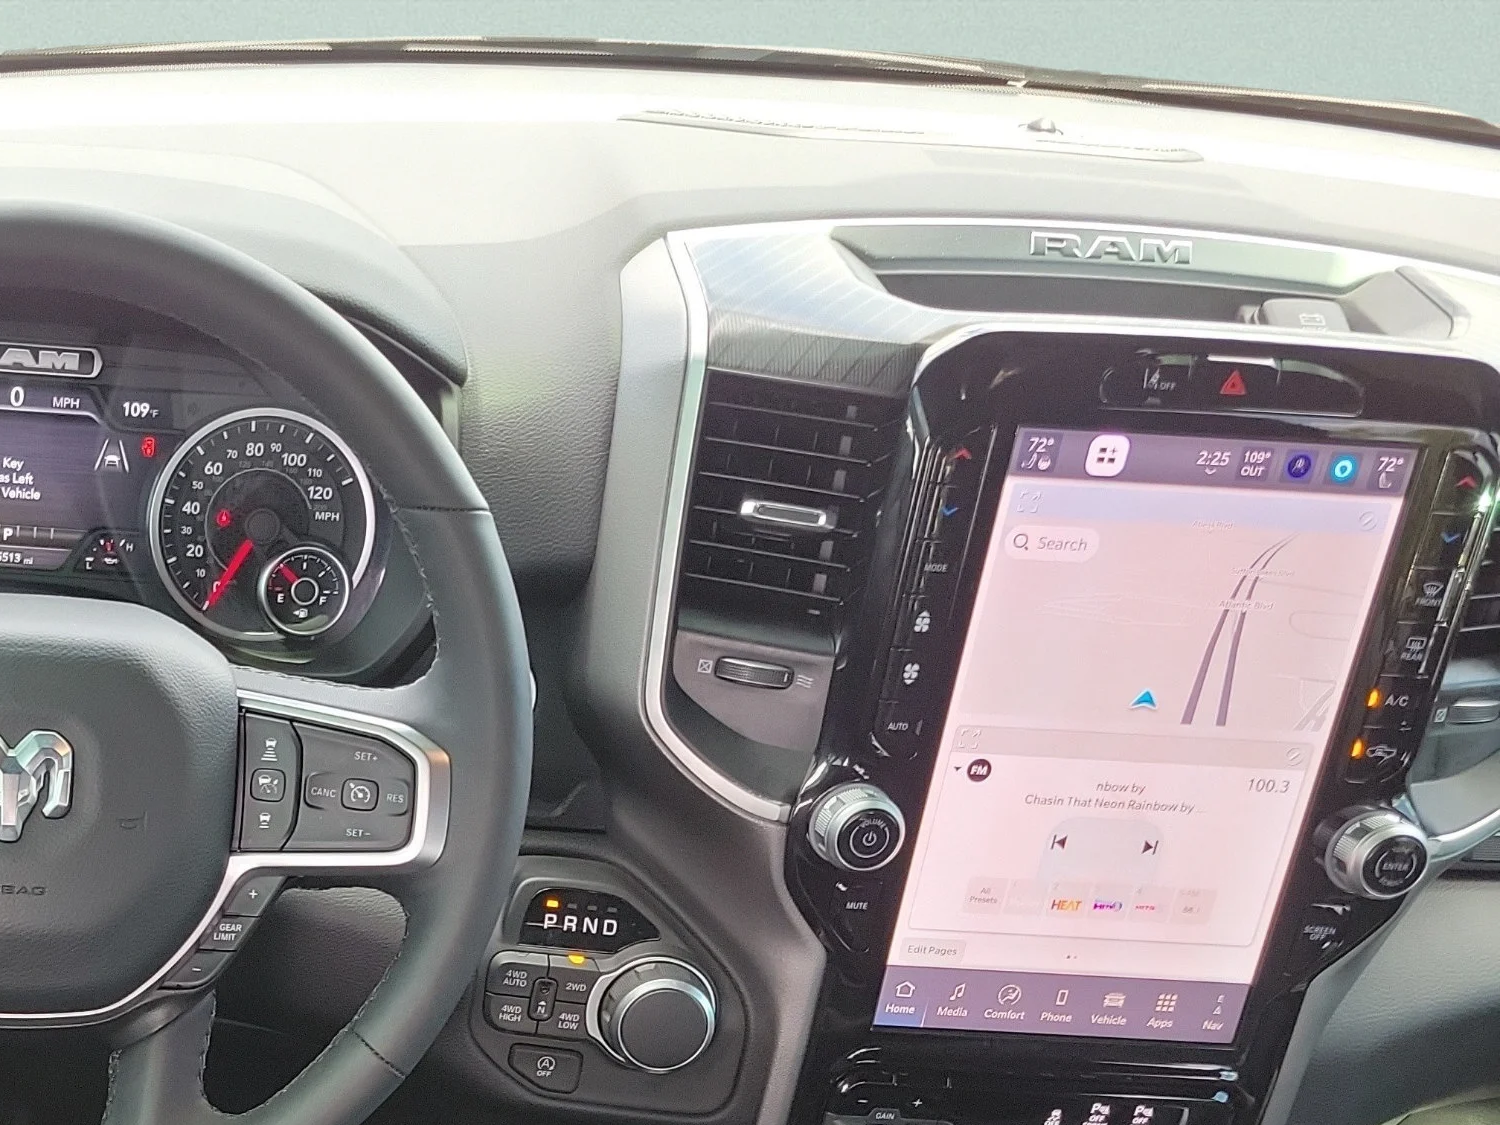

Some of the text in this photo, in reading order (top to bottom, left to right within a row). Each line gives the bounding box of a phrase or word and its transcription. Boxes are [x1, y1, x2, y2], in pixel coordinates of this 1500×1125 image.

[1029, 231, 1193, 264] RAM
[1159, 381, 1177, 391] OFF
[10, 386, 80, 409] 0 MPH
[245, 442, 264, 457] 80
[270, 443, 282, 453] 90
[226, 449, 238, 459] 70
[1197, 450, 1231, 467] 2:25
[2, 456, 25, 471] Key
[281, 453, 307, 467] 100
[204, 461, 223, 475] 60
[307, 468, 323, 478] 110
[1240, 466, 1266, 478] OUT
[12, 472, 34, 485] Left
[192, 481, 203, 490] 50
[1, 486, 41, 500] Vehicle
[307, 486, 333, 500] 120
[182, 501, 201, 515] 40
[314, 511, 340, 522] MPH
[3, 528, 13, 541] P
[181, 526, 193, 536] 30
[125, 542, 134, 552] H
[1036, 535, 1088, 552] Search
[186, 544, 204, 558] 20
[23, 556, 34, 565] mi
[195, 568, 206, 578] 10
[923, 563, 948, 573] MODE
[277, 593, 285, 604] E
[319, 596, 327, 606] F
[1384, 694, 1409, 707] A/C
[887, 722, 909, 731] AUTO
[969, 765, 989, 776] FM
[1096, 781, 1146, 796] nbow by
[1248, 777, 1290, 794] 100.3
[310, 786, 337, 798] CANC
[386, 793, 405, 803] RES
[1024, 794, 1195, 815] Chasin That Neon Rainbow by
[860, 818, 886, 829] VOLUME
[1382, 863, 1409, 871] ENTER
[969, 895, 998, 904] Presets
[1050, 899, 1083, 911] HEAT
[845, 901, 868, 910] MUTE
[219, 923, 242, 932] GEAR
[543, 914, 618, 935] P R N D
[1303, 925, 1336, 935] SCREEN
[213, 932, 237, 941] LIMIT
[907, 944, 957, 956] Edit Pages
[505, 969, 528, 979] 4WD
[502, 977, 528, 987] AUTO
[565, 982, 587, 992] 2WD
[500, 1004, 522, 1014] 4WD
[537, 1006, 546, 1015] N
[885, 1003, 916, 1014] Home
[936, 1006, 968, 1017] Media
[984, 1008, 1025, 1020] Comfort
[498, 1012, 521, 1022] HIGH
[558, 1013, 580, 1022] 4WD
[1040, 1011, 1072, 1023] Phone
[1091, 1014, 1127, 1026] Vehicle
[1146, 1016, 1173, 1029] Apps
[557, 1021, 580, 1030] LOW
[1202, 1020, 1223, 1031] Nav
[875, 1112, 895, 1120] GAIN
